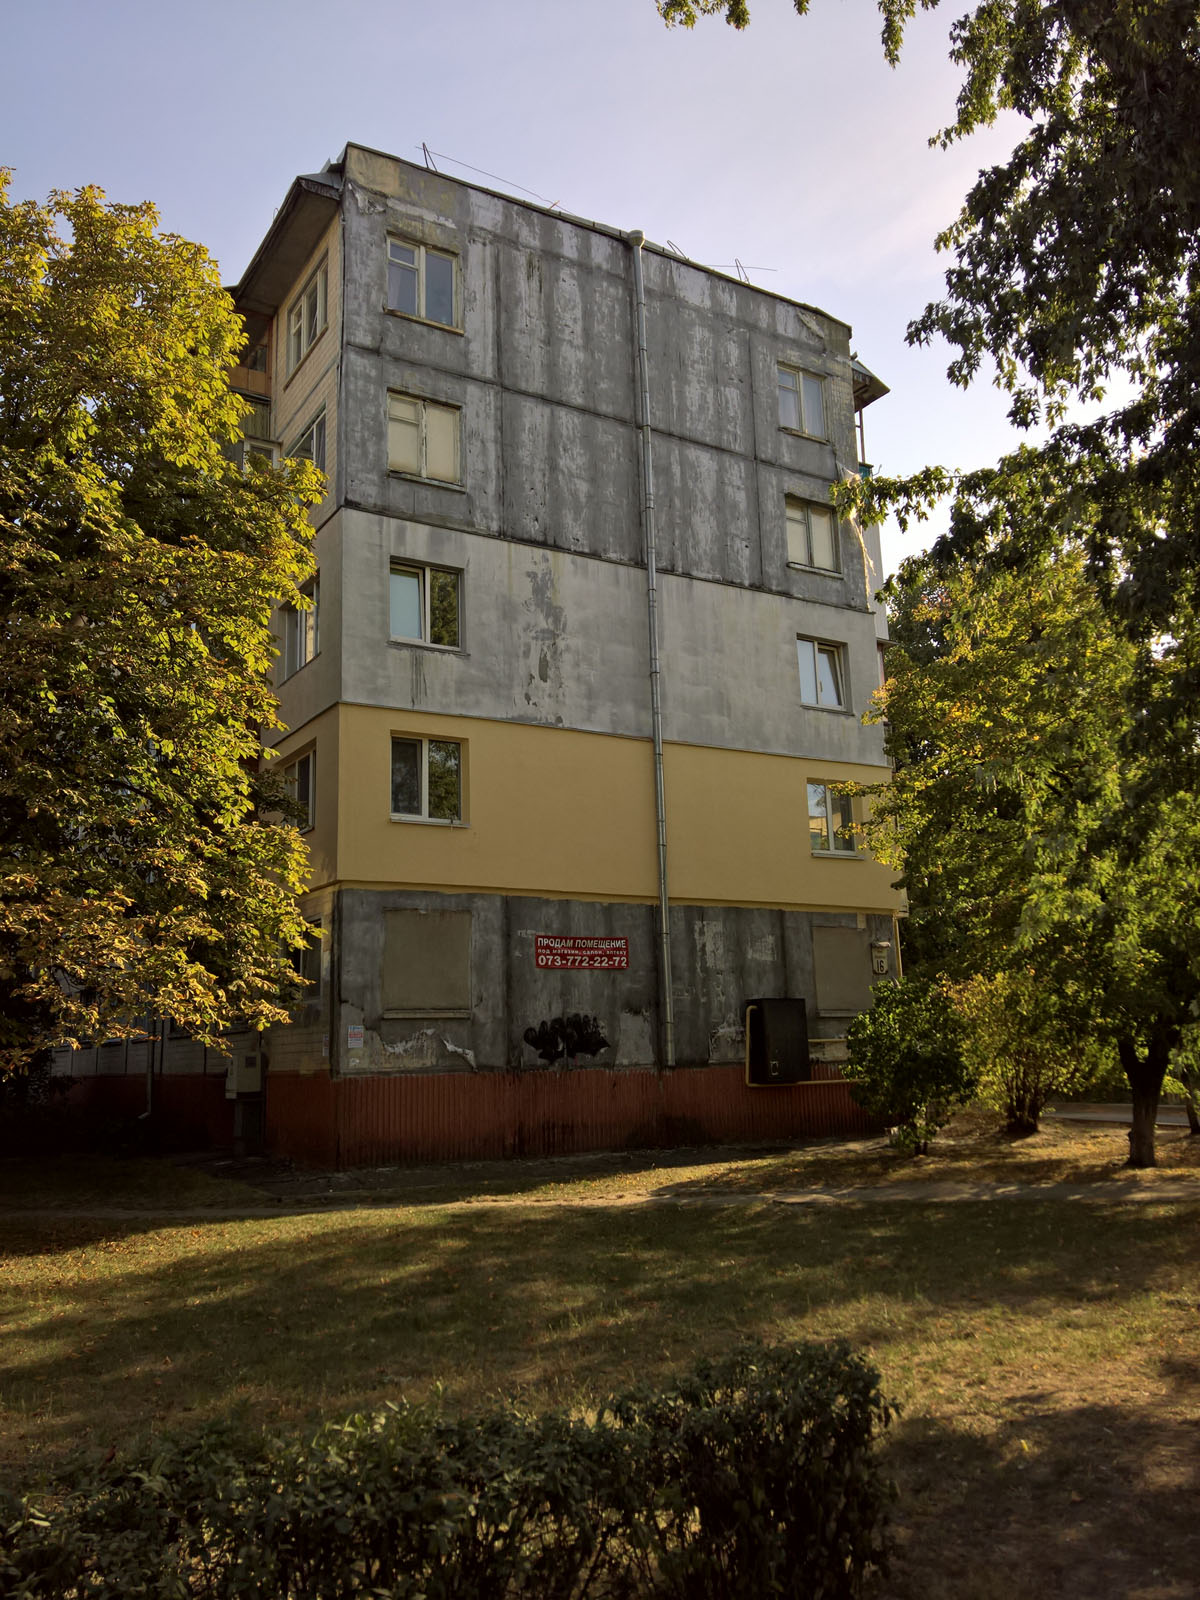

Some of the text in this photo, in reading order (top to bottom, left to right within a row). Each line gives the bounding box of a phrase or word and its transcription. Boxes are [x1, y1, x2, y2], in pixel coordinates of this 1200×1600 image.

[537, 938, 627, 949] ПРОДАМ ПОМЕЩЕНИЕ
[538, 955, 627, 967] 073-772-22-72
[877, 960, 885, 972] 16
